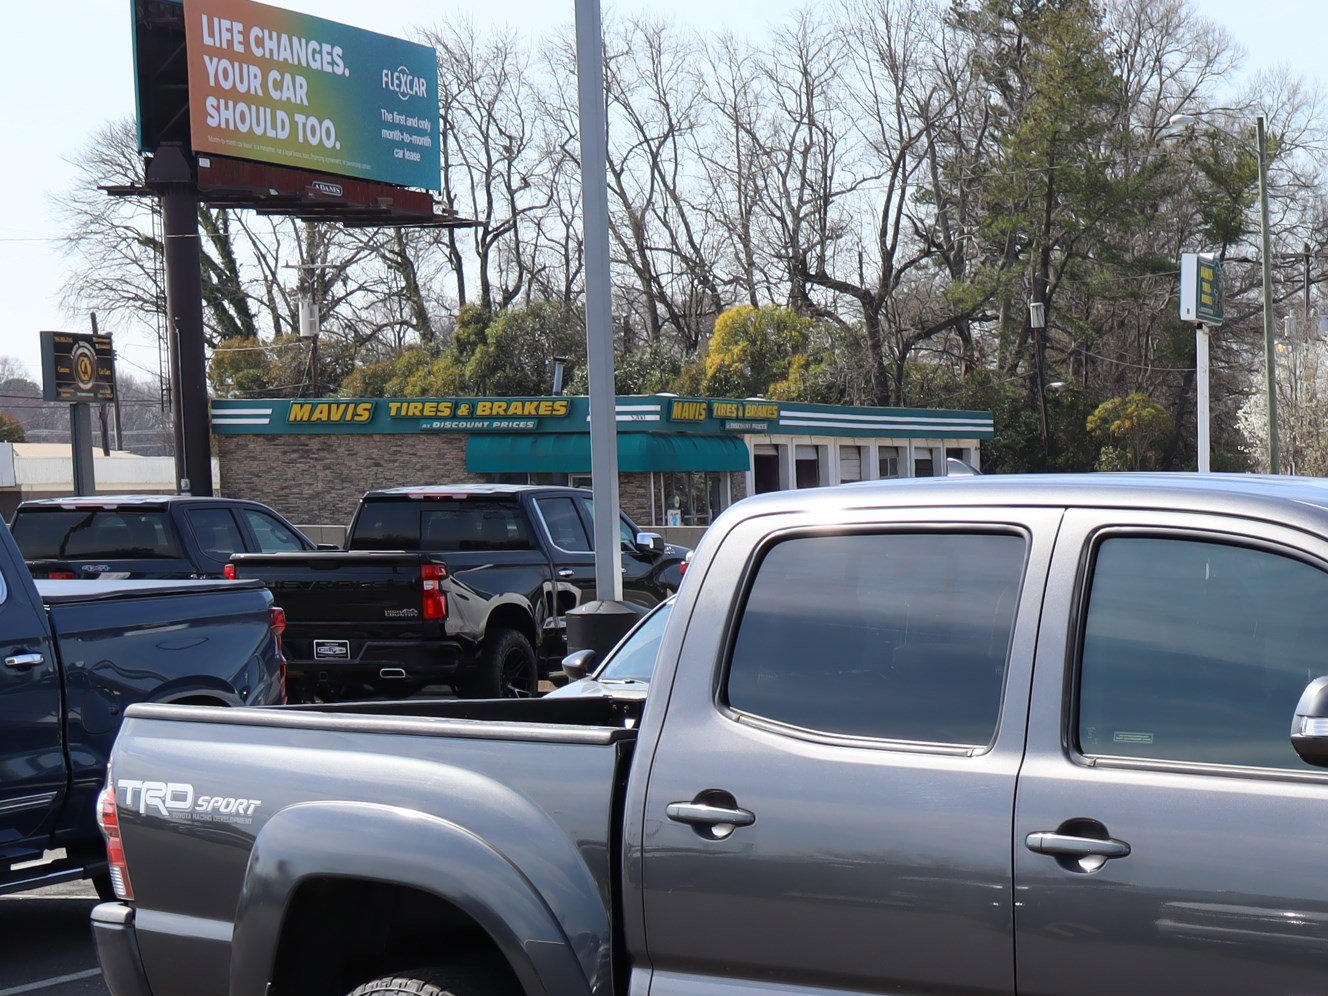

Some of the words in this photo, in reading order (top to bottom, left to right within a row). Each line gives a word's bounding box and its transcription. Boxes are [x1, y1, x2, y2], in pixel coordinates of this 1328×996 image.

[202, 14, 245, 53] LIFE
[250, 26, 350, 77] CHANGES.
[203, 55, 263, 96] YOUR
[268, 69, 309, 106] CAR
[382, 68, 427, 98] FLEXCAR
[205, 96, 290, 140] SHOULD
[294, 113, 341, 150] TOO.
[381, 109, 393, 122] The
[394, 111, 406, 125] first
[407, 117, 418, 128] and
[419, 119, 432, 132] only
[381, 128, 432, 147] month-to-month
[394, 149, 404, 158] car
[404, 148, 421, 162] lease
[289, 403, 373, 422] MAVIS
[389, 402, 453, 417] TIRES
[458, 403, 469, 416] &
[476, 401, 568, 416] BRAKES
[672, 402, 708, 420] MAVIS
[713, 402, 737, 418] TIRES
[745, 404, 778, 419] BRAKES
[118, 779, 194, 817] TRD
[195, 796, 261, 816] SPORT
[172, 812, 191, 820] TOYOTA
[192, 813, 212, 822] RACING
[213, 815, 252, 825] DEVELOPMENT
